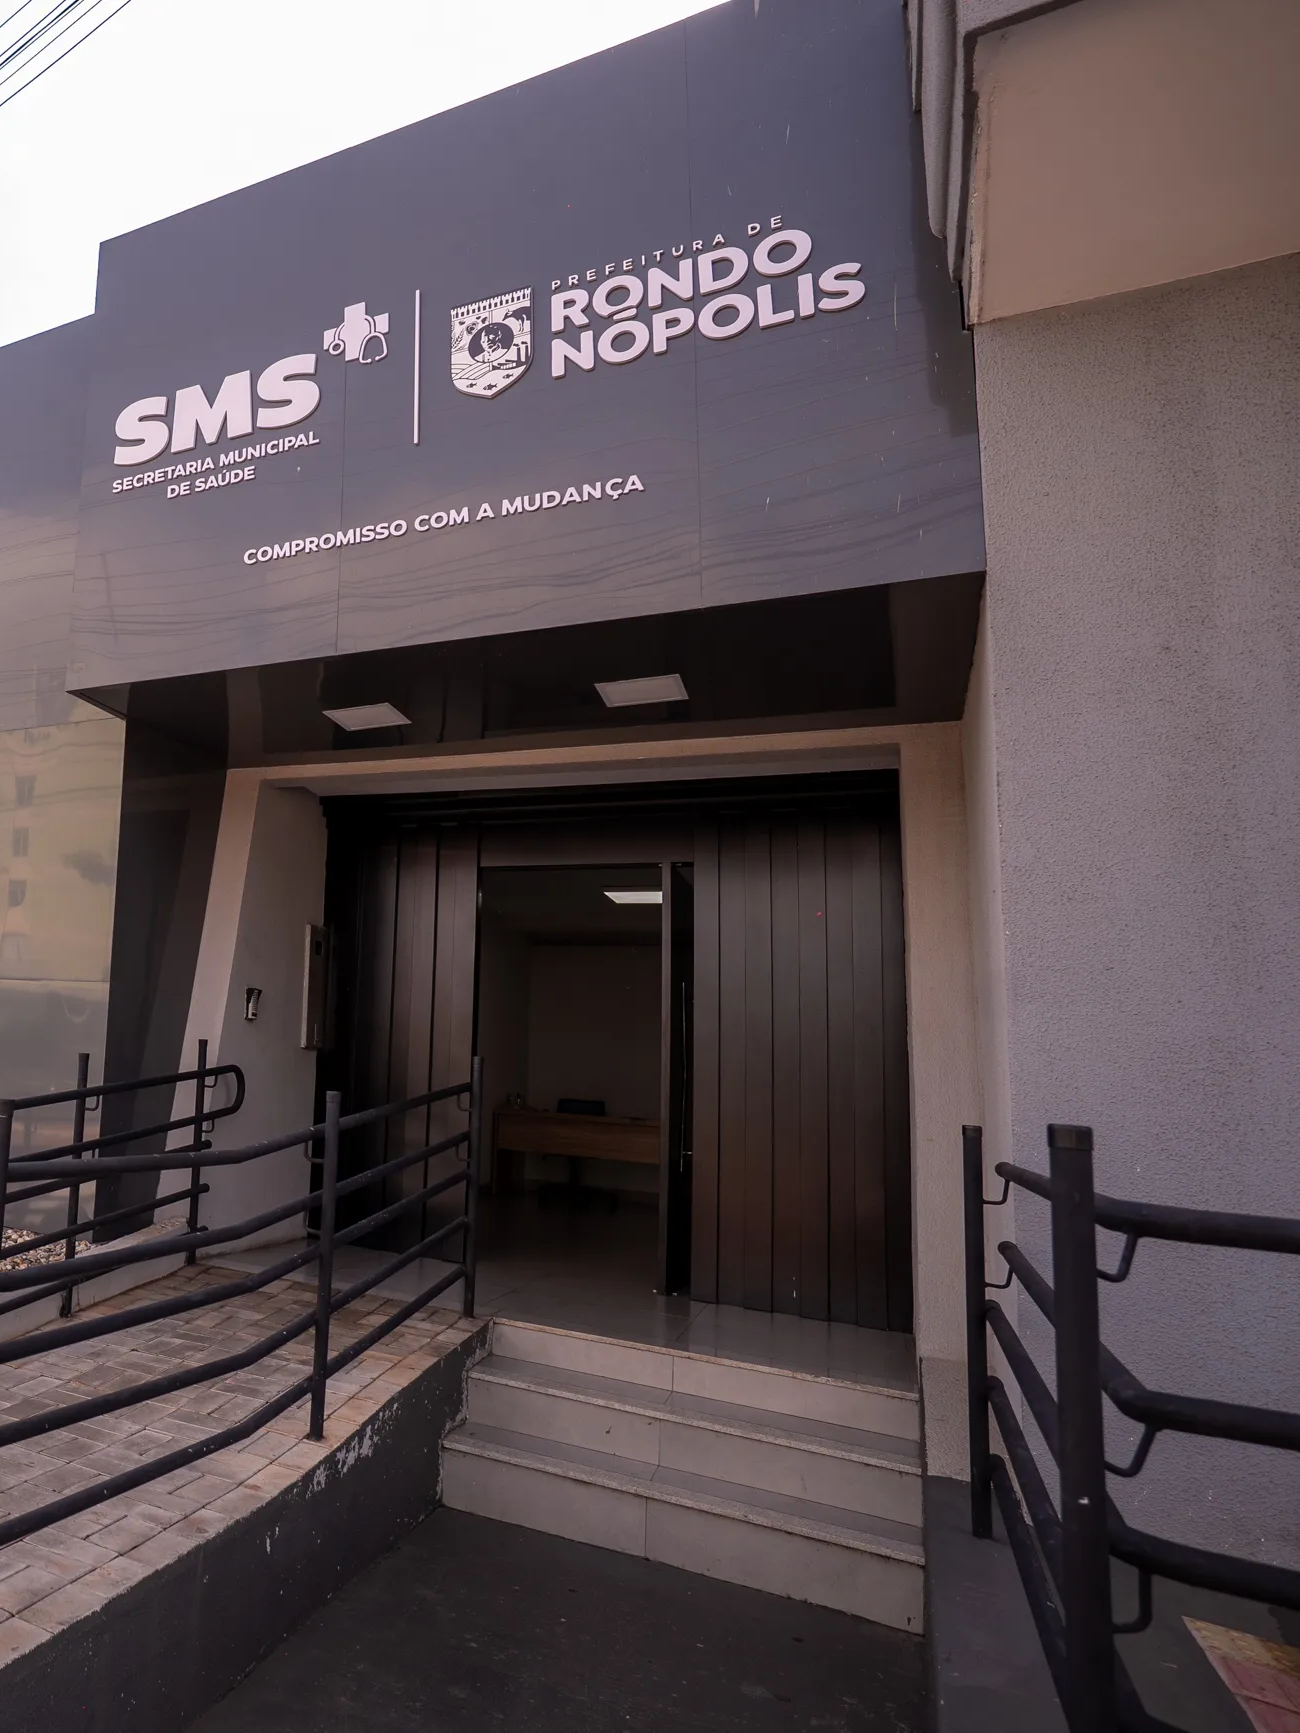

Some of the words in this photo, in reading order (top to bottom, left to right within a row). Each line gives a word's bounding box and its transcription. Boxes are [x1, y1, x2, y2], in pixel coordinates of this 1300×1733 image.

[550, 229, 813, 334] RONDO
[551, 233, 726, 291] PREFEITURA
[747, 215, 784, 237] DE
[113, 353, 321, 466] SMS
[112, 457, 215, 493] SECRETARIA
[219, 431, 320, 468] MUNICIPAL
[167, 482, 191, 499] DE
[195, 466, 256, 492] SAÚDE
[243, 519, 408, 565] COMPROMISSO
[414, 506, 470, 532] COM
[476, 502, 496, 522] A
[501, 474, 645, 516] MUDANÇA
